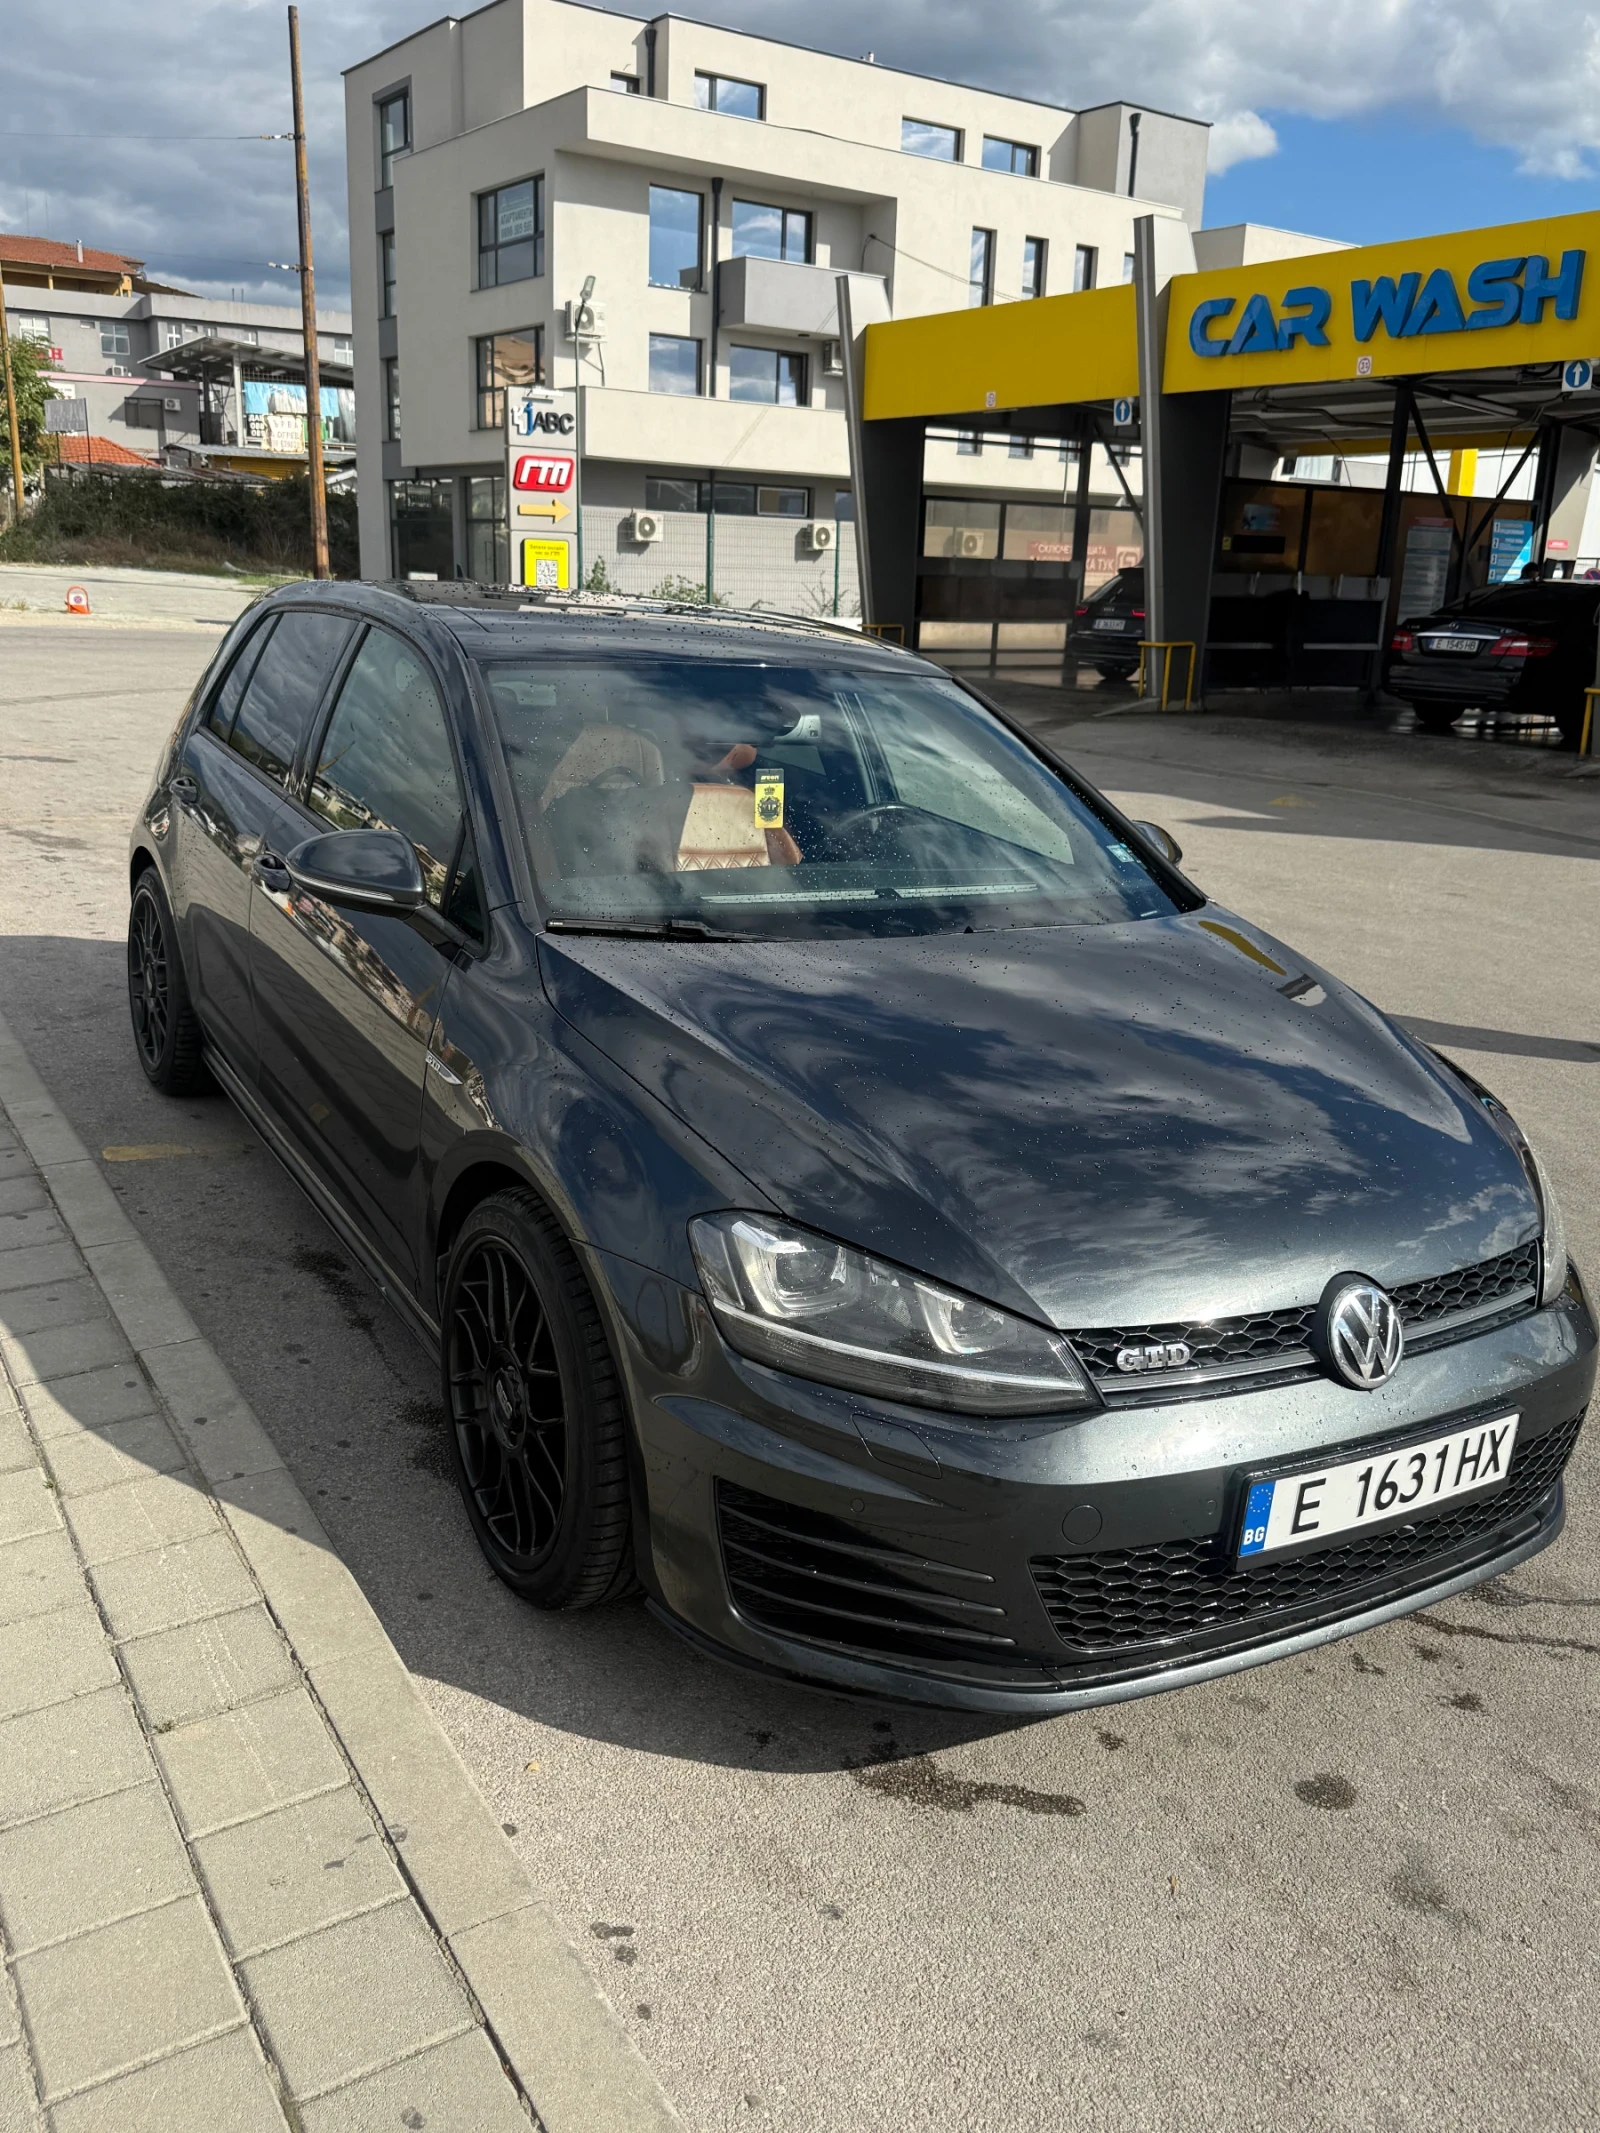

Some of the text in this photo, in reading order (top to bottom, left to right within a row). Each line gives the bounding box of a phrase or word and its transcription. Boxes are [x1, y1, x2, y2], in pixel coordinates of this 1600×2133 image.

[1189, 250, 1586, 357] CAR WASH
[533, 411, 575, 435] ABC
[519, 459, 571, 486] ГТП
[1436, 639, 1442, 650] E
[1116, 1342, 1190, 1372] GTD
[1290, 1478, 1326, 1535] E
[1243, 1526, 1265, 1545] BG
